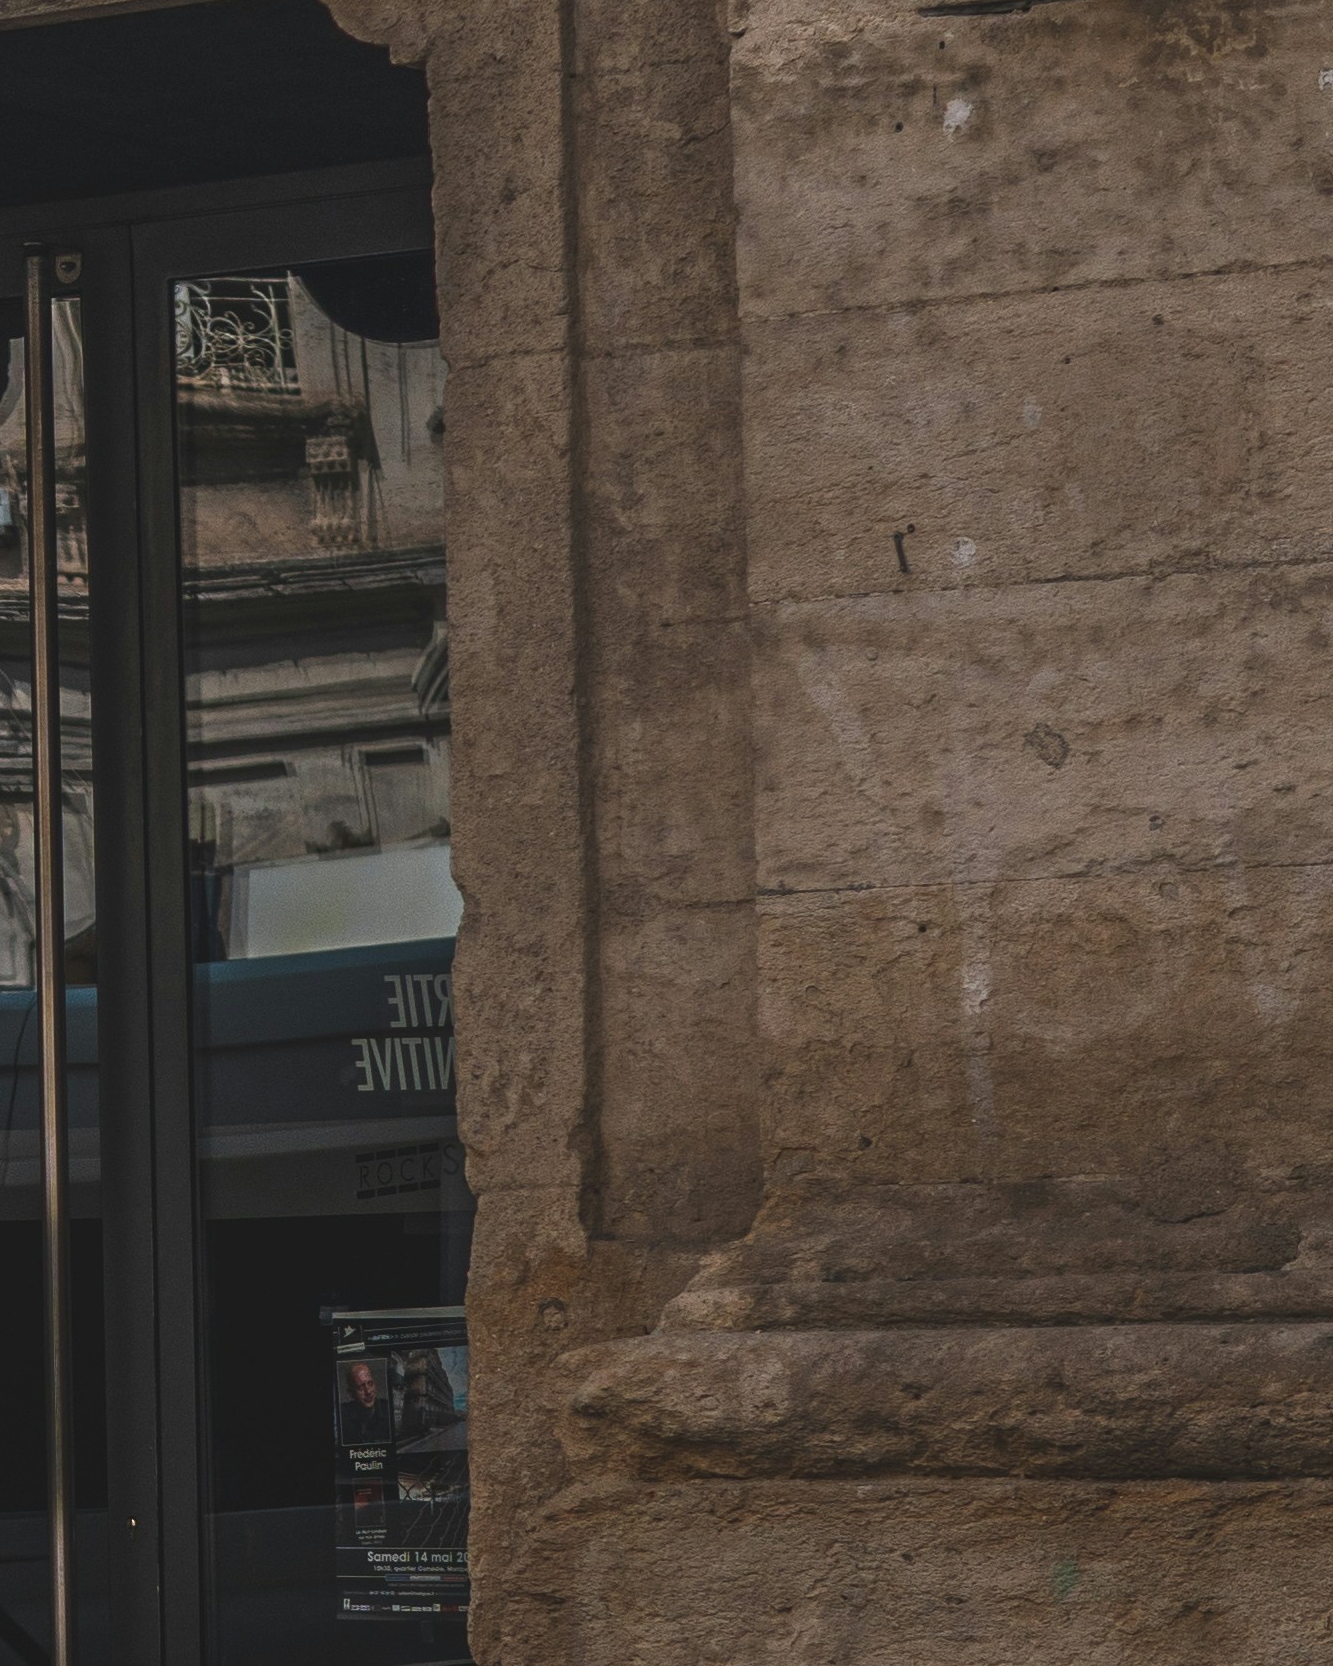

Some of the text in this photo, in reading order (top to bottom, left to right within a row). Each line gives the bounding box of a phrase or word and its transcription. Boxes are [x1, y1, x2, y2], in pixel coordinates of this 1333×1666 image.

[349, 1446, 387, 1459] Frédéric
[355, 1460, 383, 1471] Paulin
[367, 1551, 410, 1563] Samedi
[414, 1551, 428, 1563] 14
[431, 1551, 453, 1563] mai
